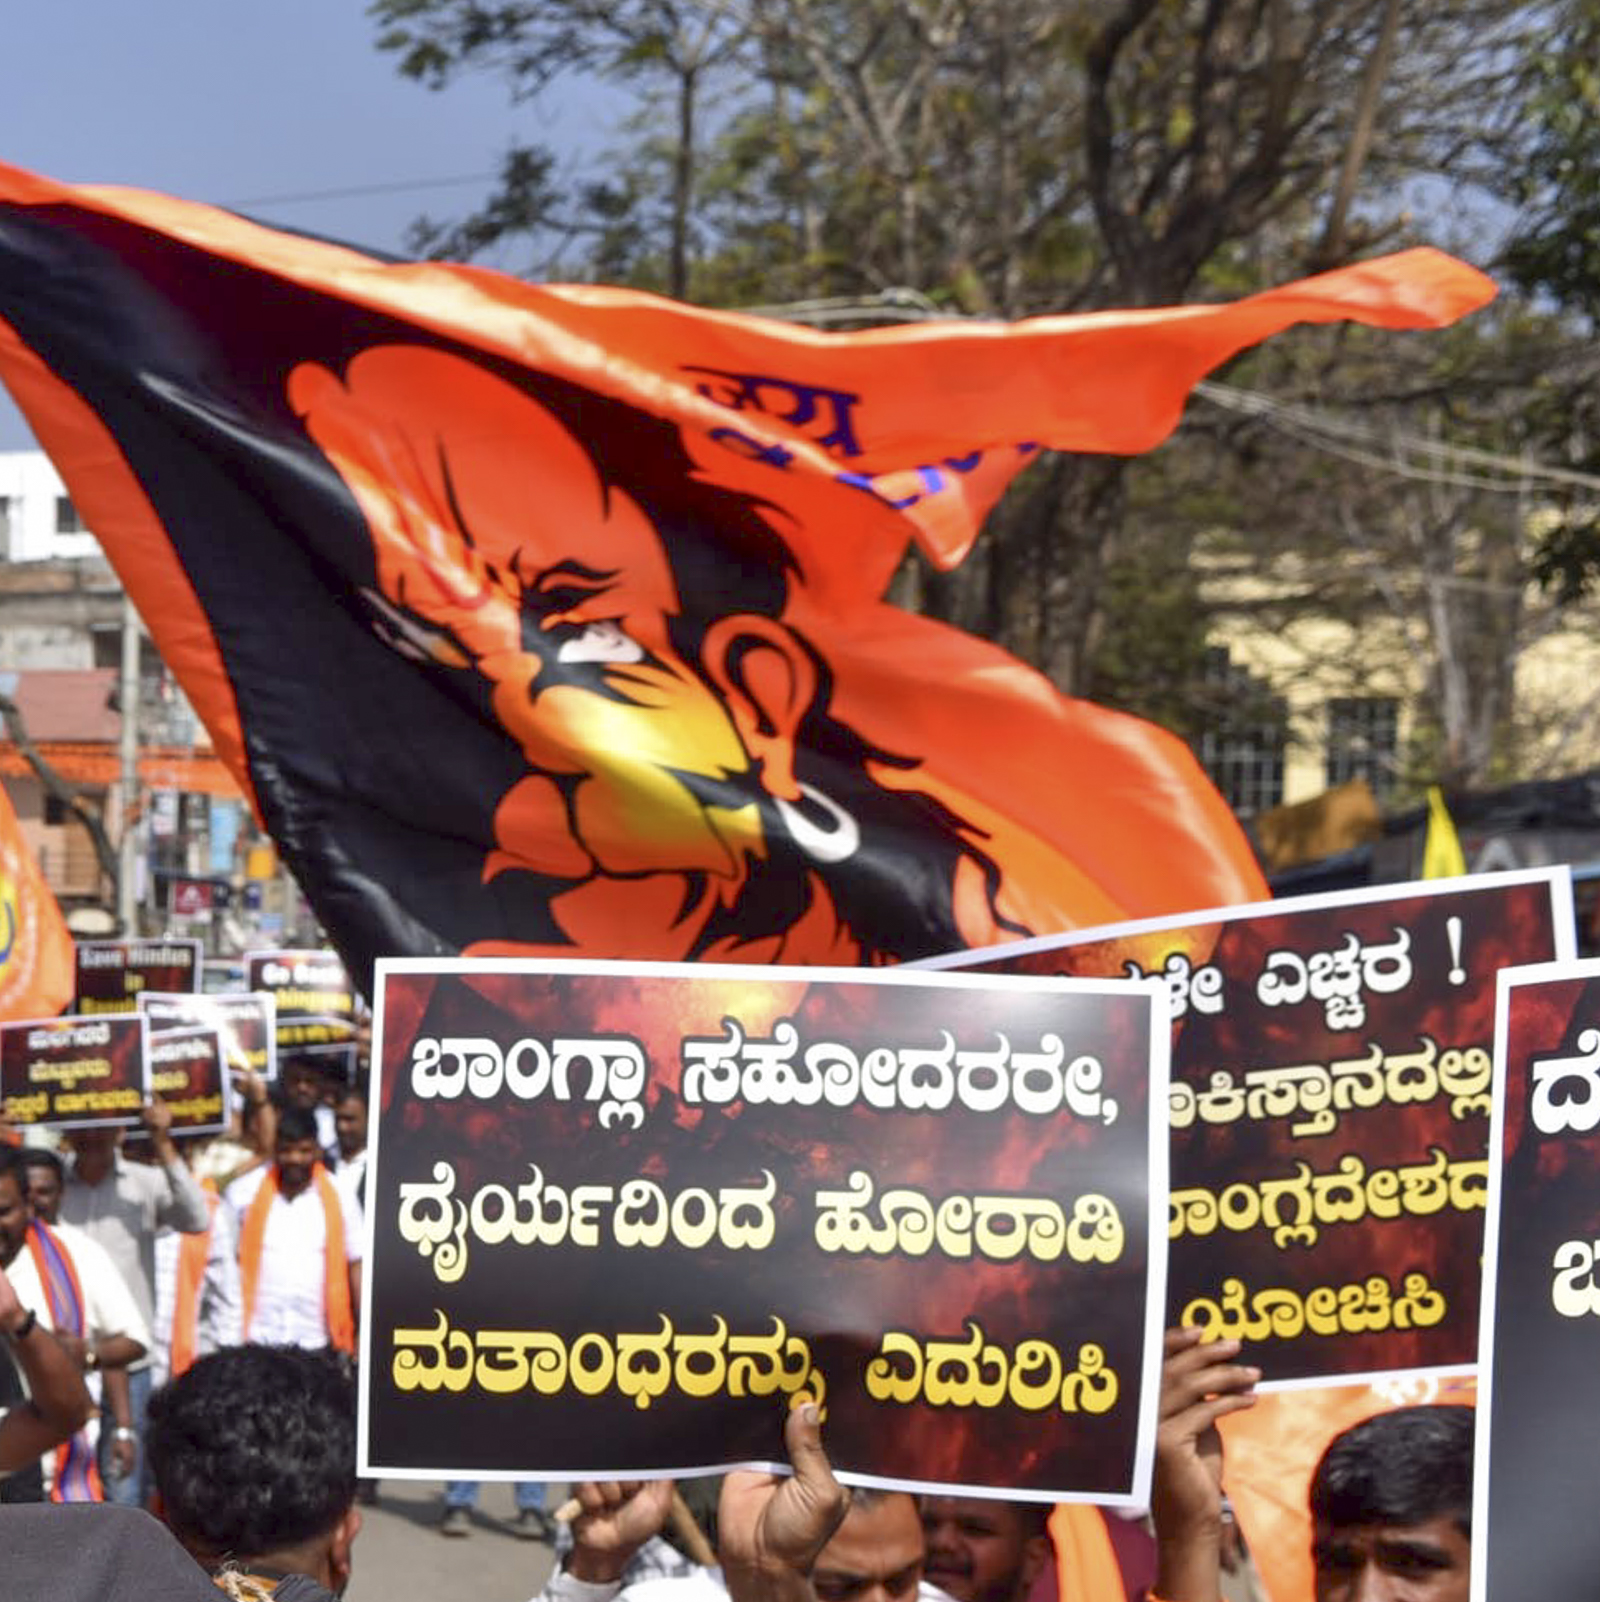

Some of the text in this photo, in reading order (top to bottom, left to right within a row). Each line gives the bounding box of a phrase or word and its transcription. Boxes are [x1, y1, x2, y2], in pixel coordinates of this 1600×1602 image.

[411, 1017, 1120, 1130] ಬಾಂಗ್ಲಾ ಸಹೋದರರೇ,
[397, 1161, 1125, 1283] ಧೈರ್ಯದಿಂದ ಹೋರಾಡಿ
[1181, 1273, 1447, 1345] ಯೋಚಿಸಿ
[866, 1320, 1120, 1415] ಎದುರಿಸಿ
